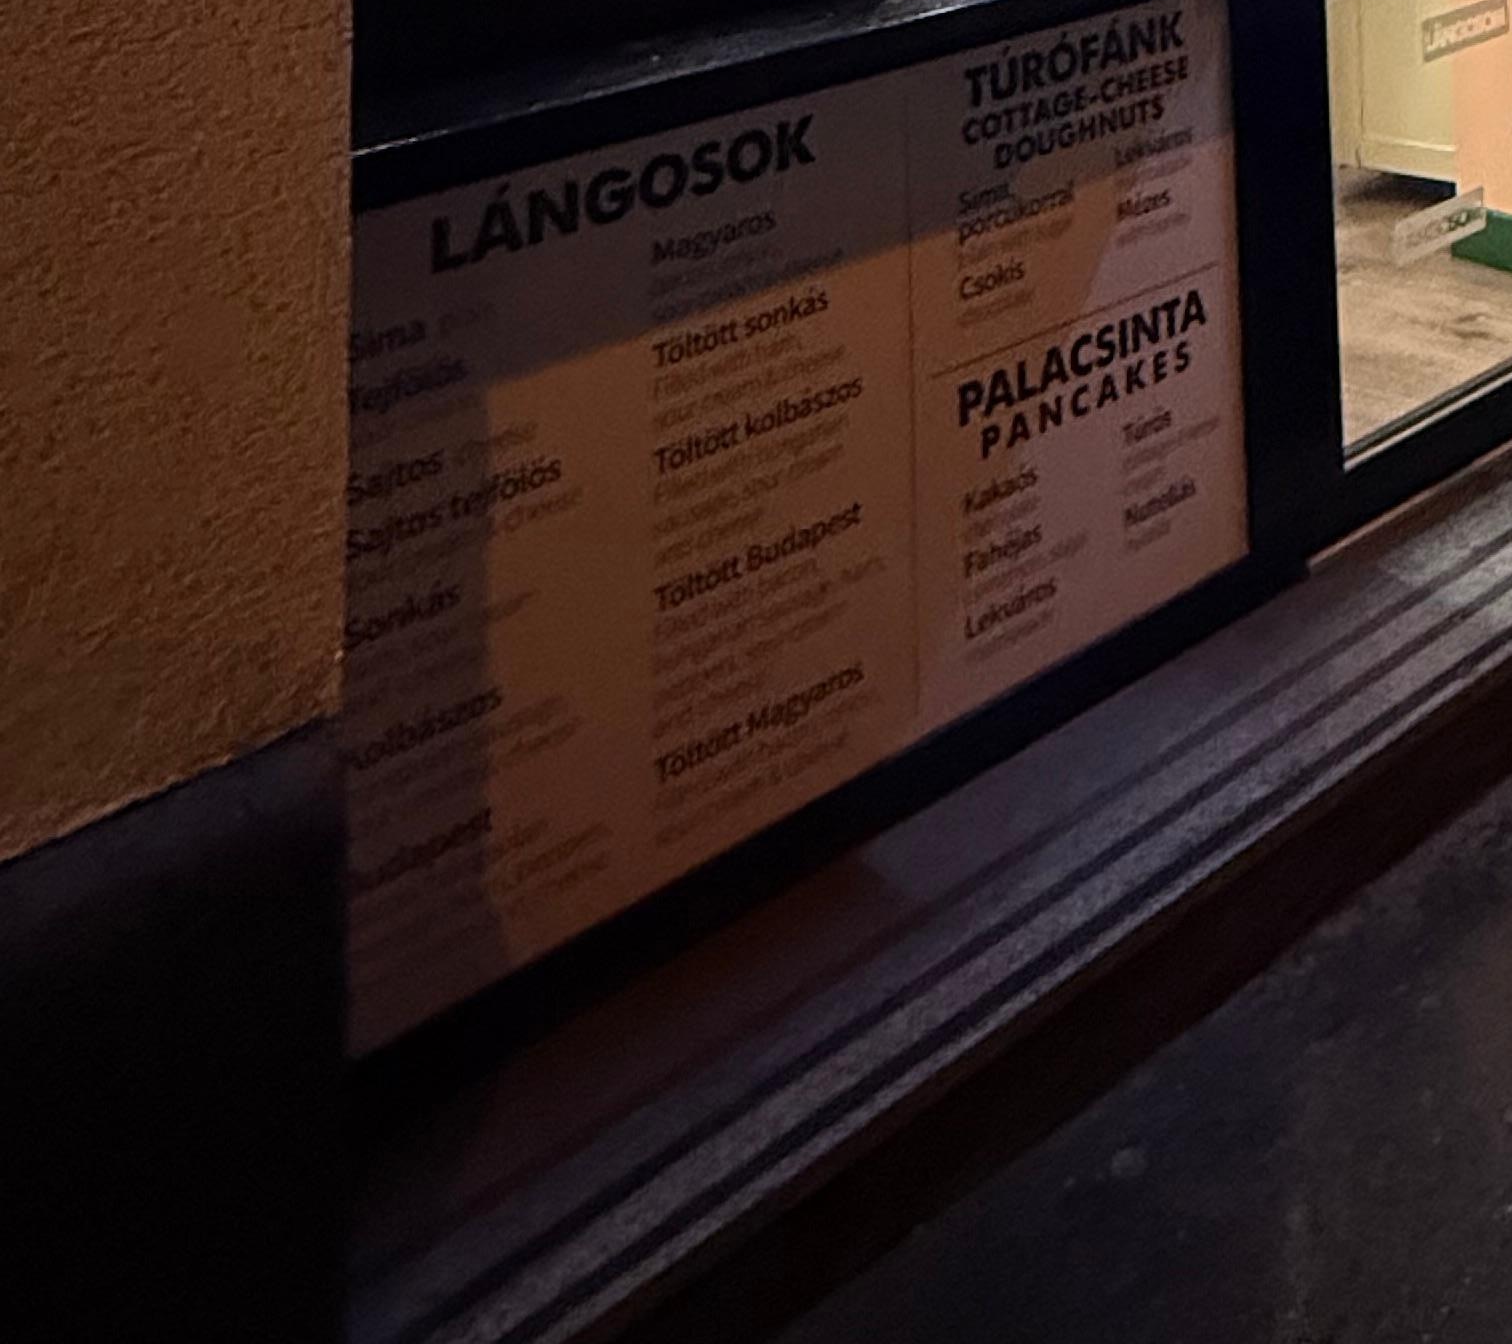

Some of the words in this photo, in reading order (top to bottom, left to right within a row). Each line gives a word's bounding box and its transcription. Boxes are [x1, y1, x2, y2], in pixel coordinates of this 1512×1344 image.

[961, 56, 1188, 145] COTTAGE-CHEESE
[964, 11, 1183, 108] TÚRÓFÁNK
[993, 94, 1163, 170] DOUGHNUTS
[430, 113, 817, 275] LÁNGOSOK
[958, 289, 1207, 428] PALACSINTA
[982, 340, 1192, 460] PANCAKES
[746, 501, 862, 574] Budapest
